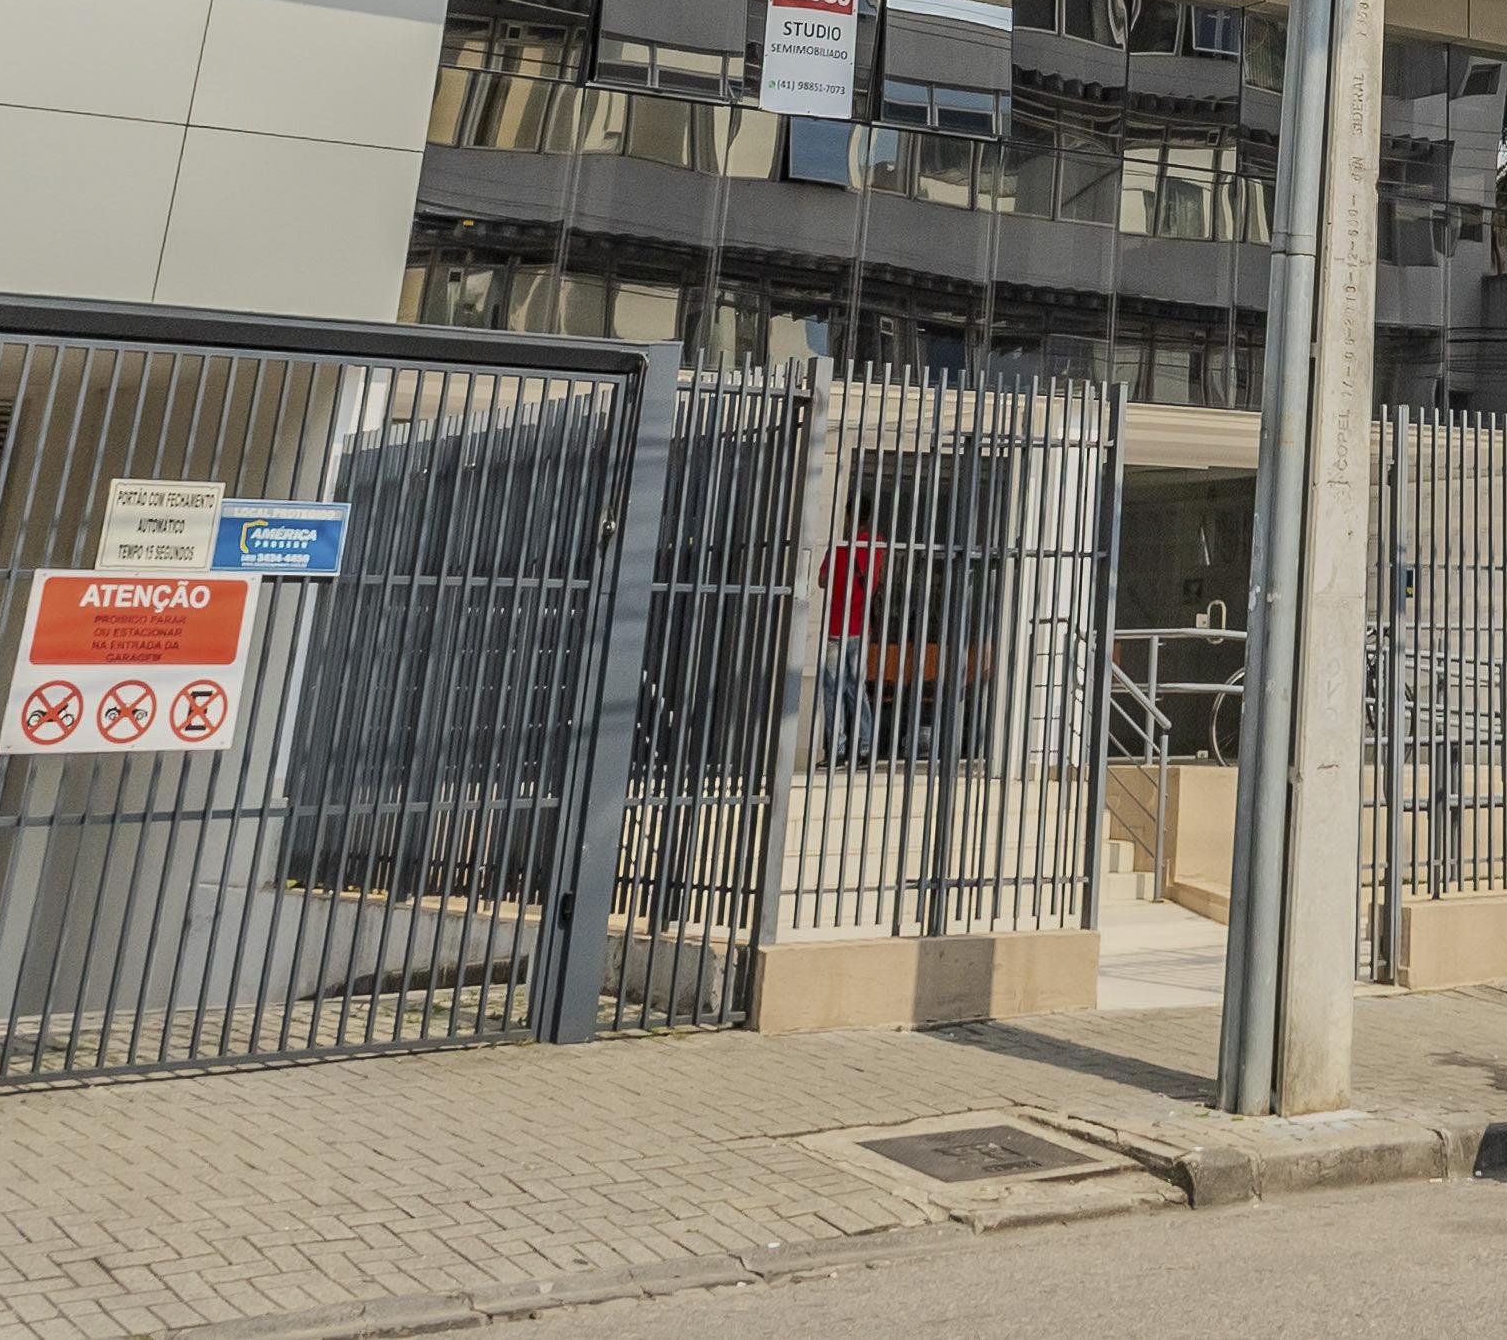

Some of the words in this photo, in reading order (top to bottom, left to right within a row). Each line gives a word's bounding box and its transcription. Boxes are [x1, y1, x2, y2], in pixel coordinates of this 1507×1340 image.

[783, 21, 842, 42] STUDIO
[771, 42, 848, 61] SEMIMOBILIADO
[777, 80, 796, 92] (41)
[797, 80, 846, 96] 98851-7073
[117, 487, 148, 507] PORTÃO
[149, 491, 166, 507] COM
[166, 492, 215, 509] FECHAMENTO
[250, 525, 318, 542] AMÉRICA
[118, 544, 144, 560] TEMPO
[155, 544, 195, 561] SEGUNDOS
[79, 581, 212, 613] ATENÇÃO
[112, 627, 184, 638] ESTACIONAR
